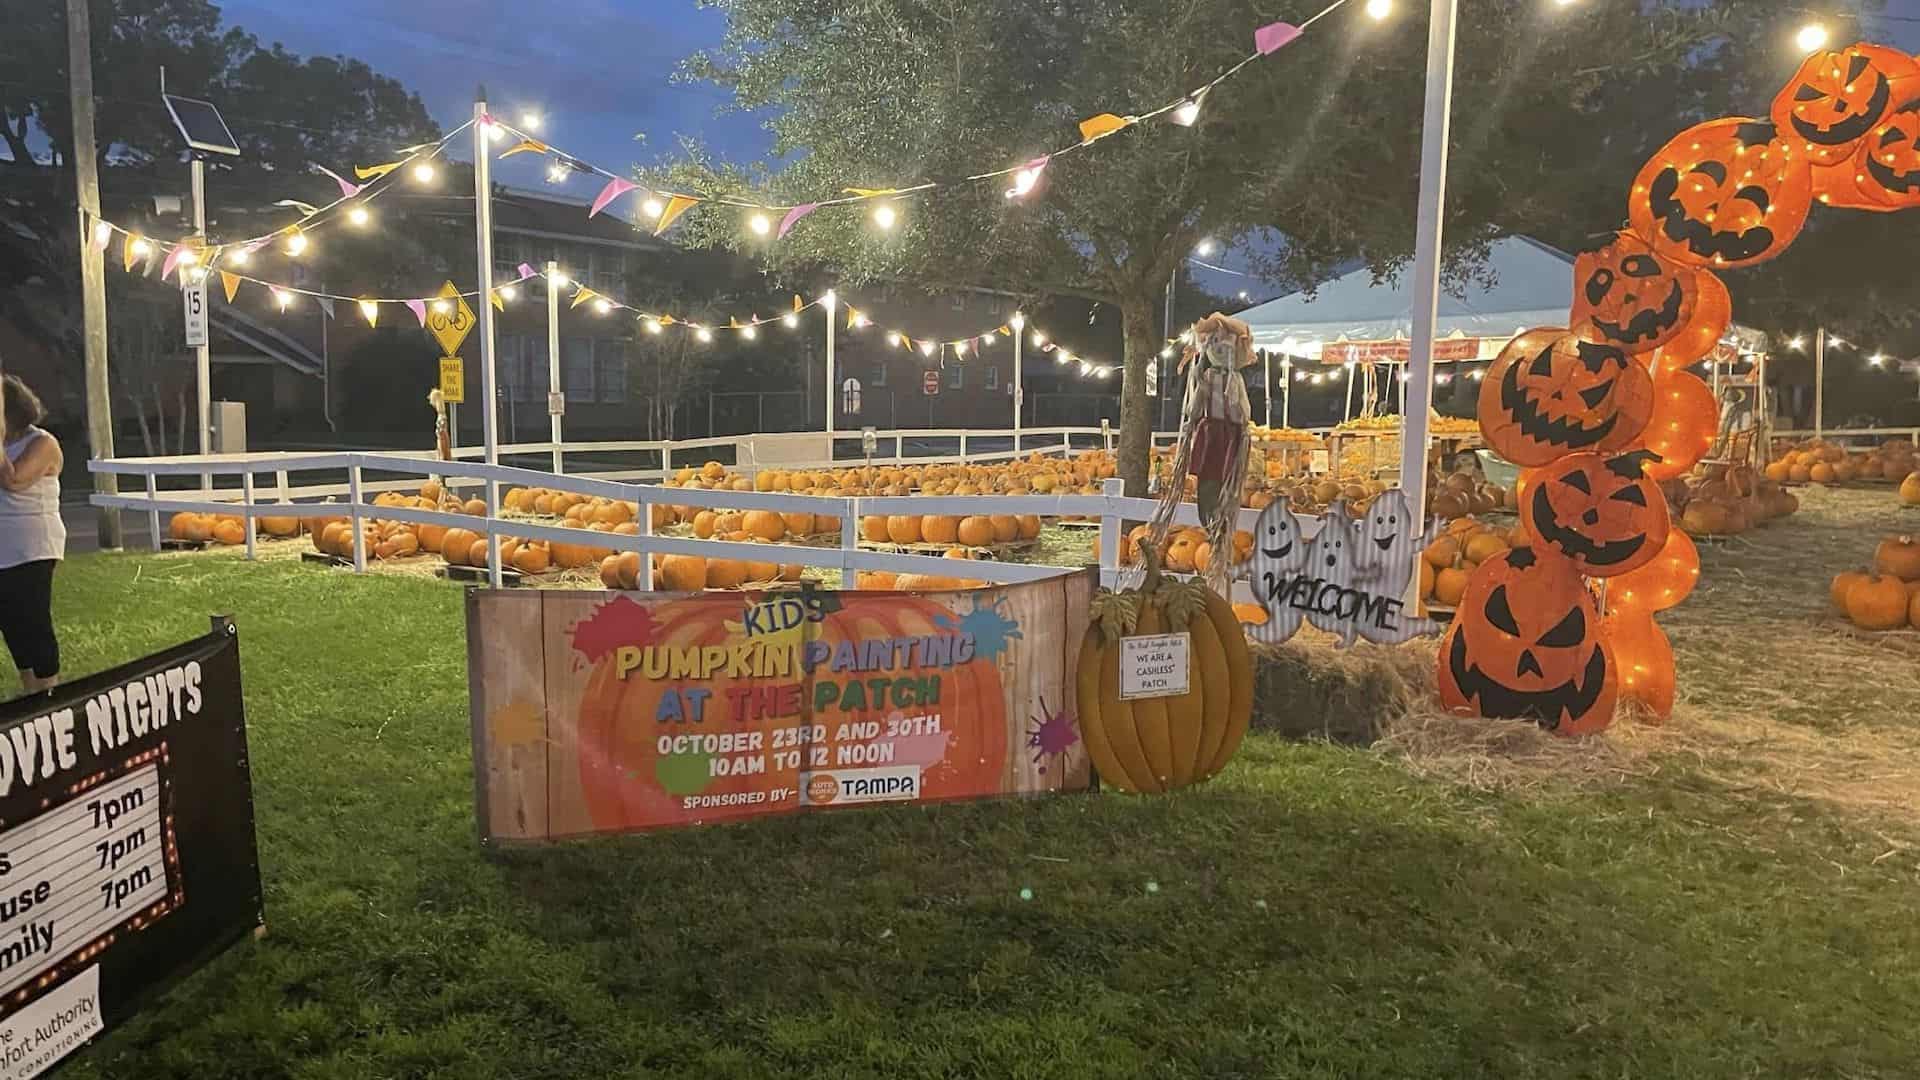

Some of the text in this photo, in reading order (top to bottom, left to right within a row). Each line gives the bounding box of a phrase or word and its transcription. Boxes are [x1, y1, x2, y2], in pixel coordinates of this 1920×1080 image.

[188, 291, 201, 315] 15
[743, 598, 825, 637] KIDS
[1263, 571, 1404, 631] WELCOME
[616, 632, 976, 681] PUMPKIN PAINTING
[1136, 654, 1148, 663] WE
[1150, 653, 1164, 662] ARE
[85, 661, 202, 756] NIGHTS
[656, 674, 941, 723] AT THE PATCH
[657, 714, 942, 755] OCTOBER 23RD AND 30TH
[709, 742, 895, 777] 10AM TO 12 NOON
[683, 791, 765, 809] SPONSORED
[842, 776, 914, 795] TAMPA
[87, 787, 144, 829] 7pm
[96, 828, 146, 870] 7pm
[101, 865, 152, 909] 7pm
[35, 994, 96, 1046] Authority
[18, 1017, 98, 1078] CONDITIONING
